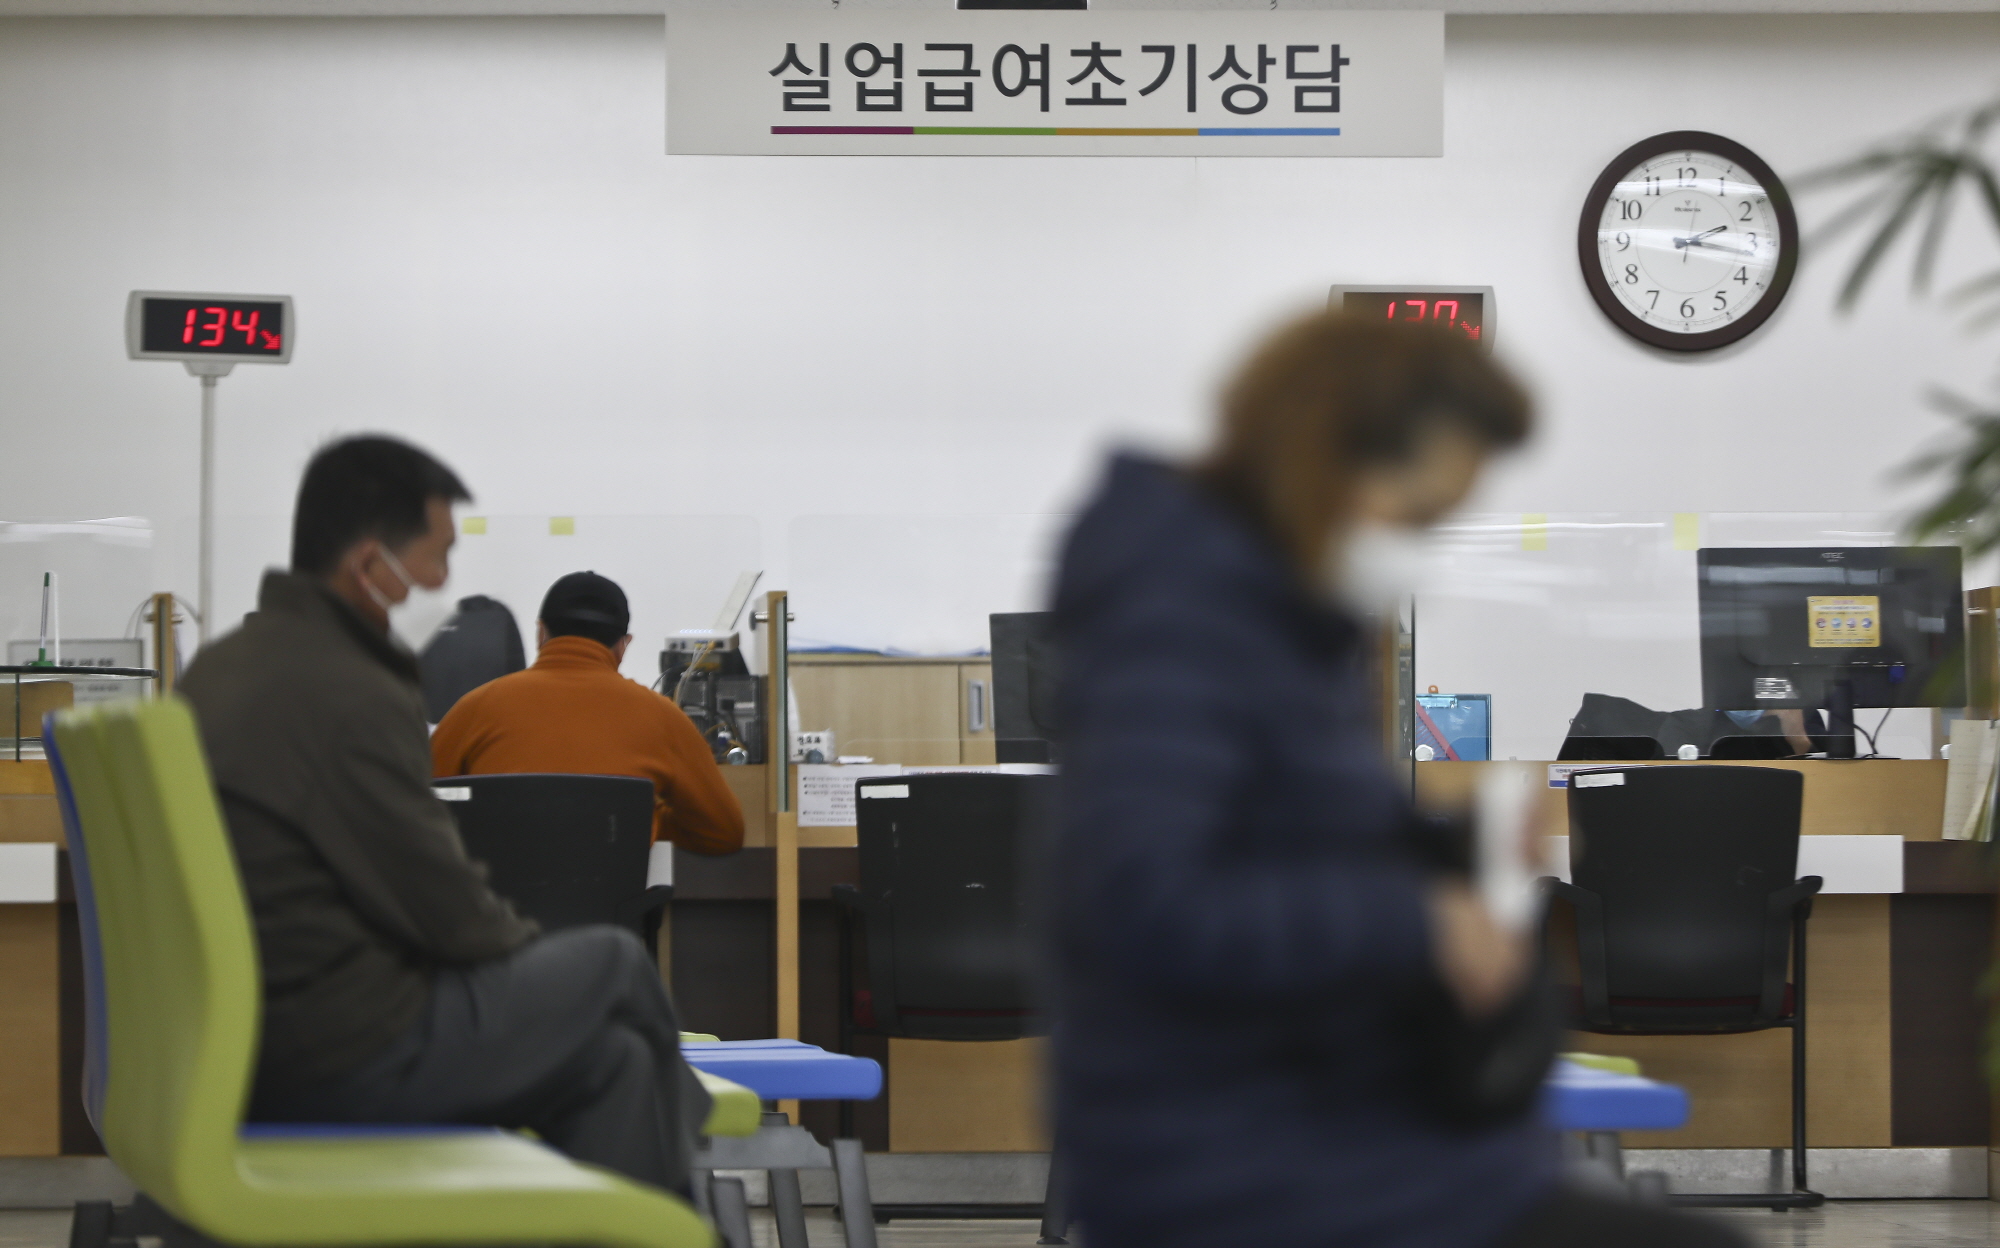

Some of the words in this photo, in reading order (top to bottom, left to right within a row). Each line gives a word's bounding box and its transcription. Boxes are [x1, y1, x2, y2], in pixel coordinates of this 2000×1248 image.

[768, 42, 1349, 115] 실업급여초기상담
[1644, 176, 1660, 197] 11
[1676, 167, 1697, 188] 12
[1717, 176, 1725, 197] 1
[1620, 199, 1642, 220] 10
[1738, 200, 1753, 222] 2
[1616, 232, 1630, 252] 9
[1747, 232, 1758, 252] 3
[1625, 264, 1638, 284] 8
[1733, 266, 1749, 285] 4
[1645, 289, 1660, 310] 7
[1680, 297, 1695, 318] 6
[1713, 291, 1727, 311] 5
[182, 306, 261, 347] 134
